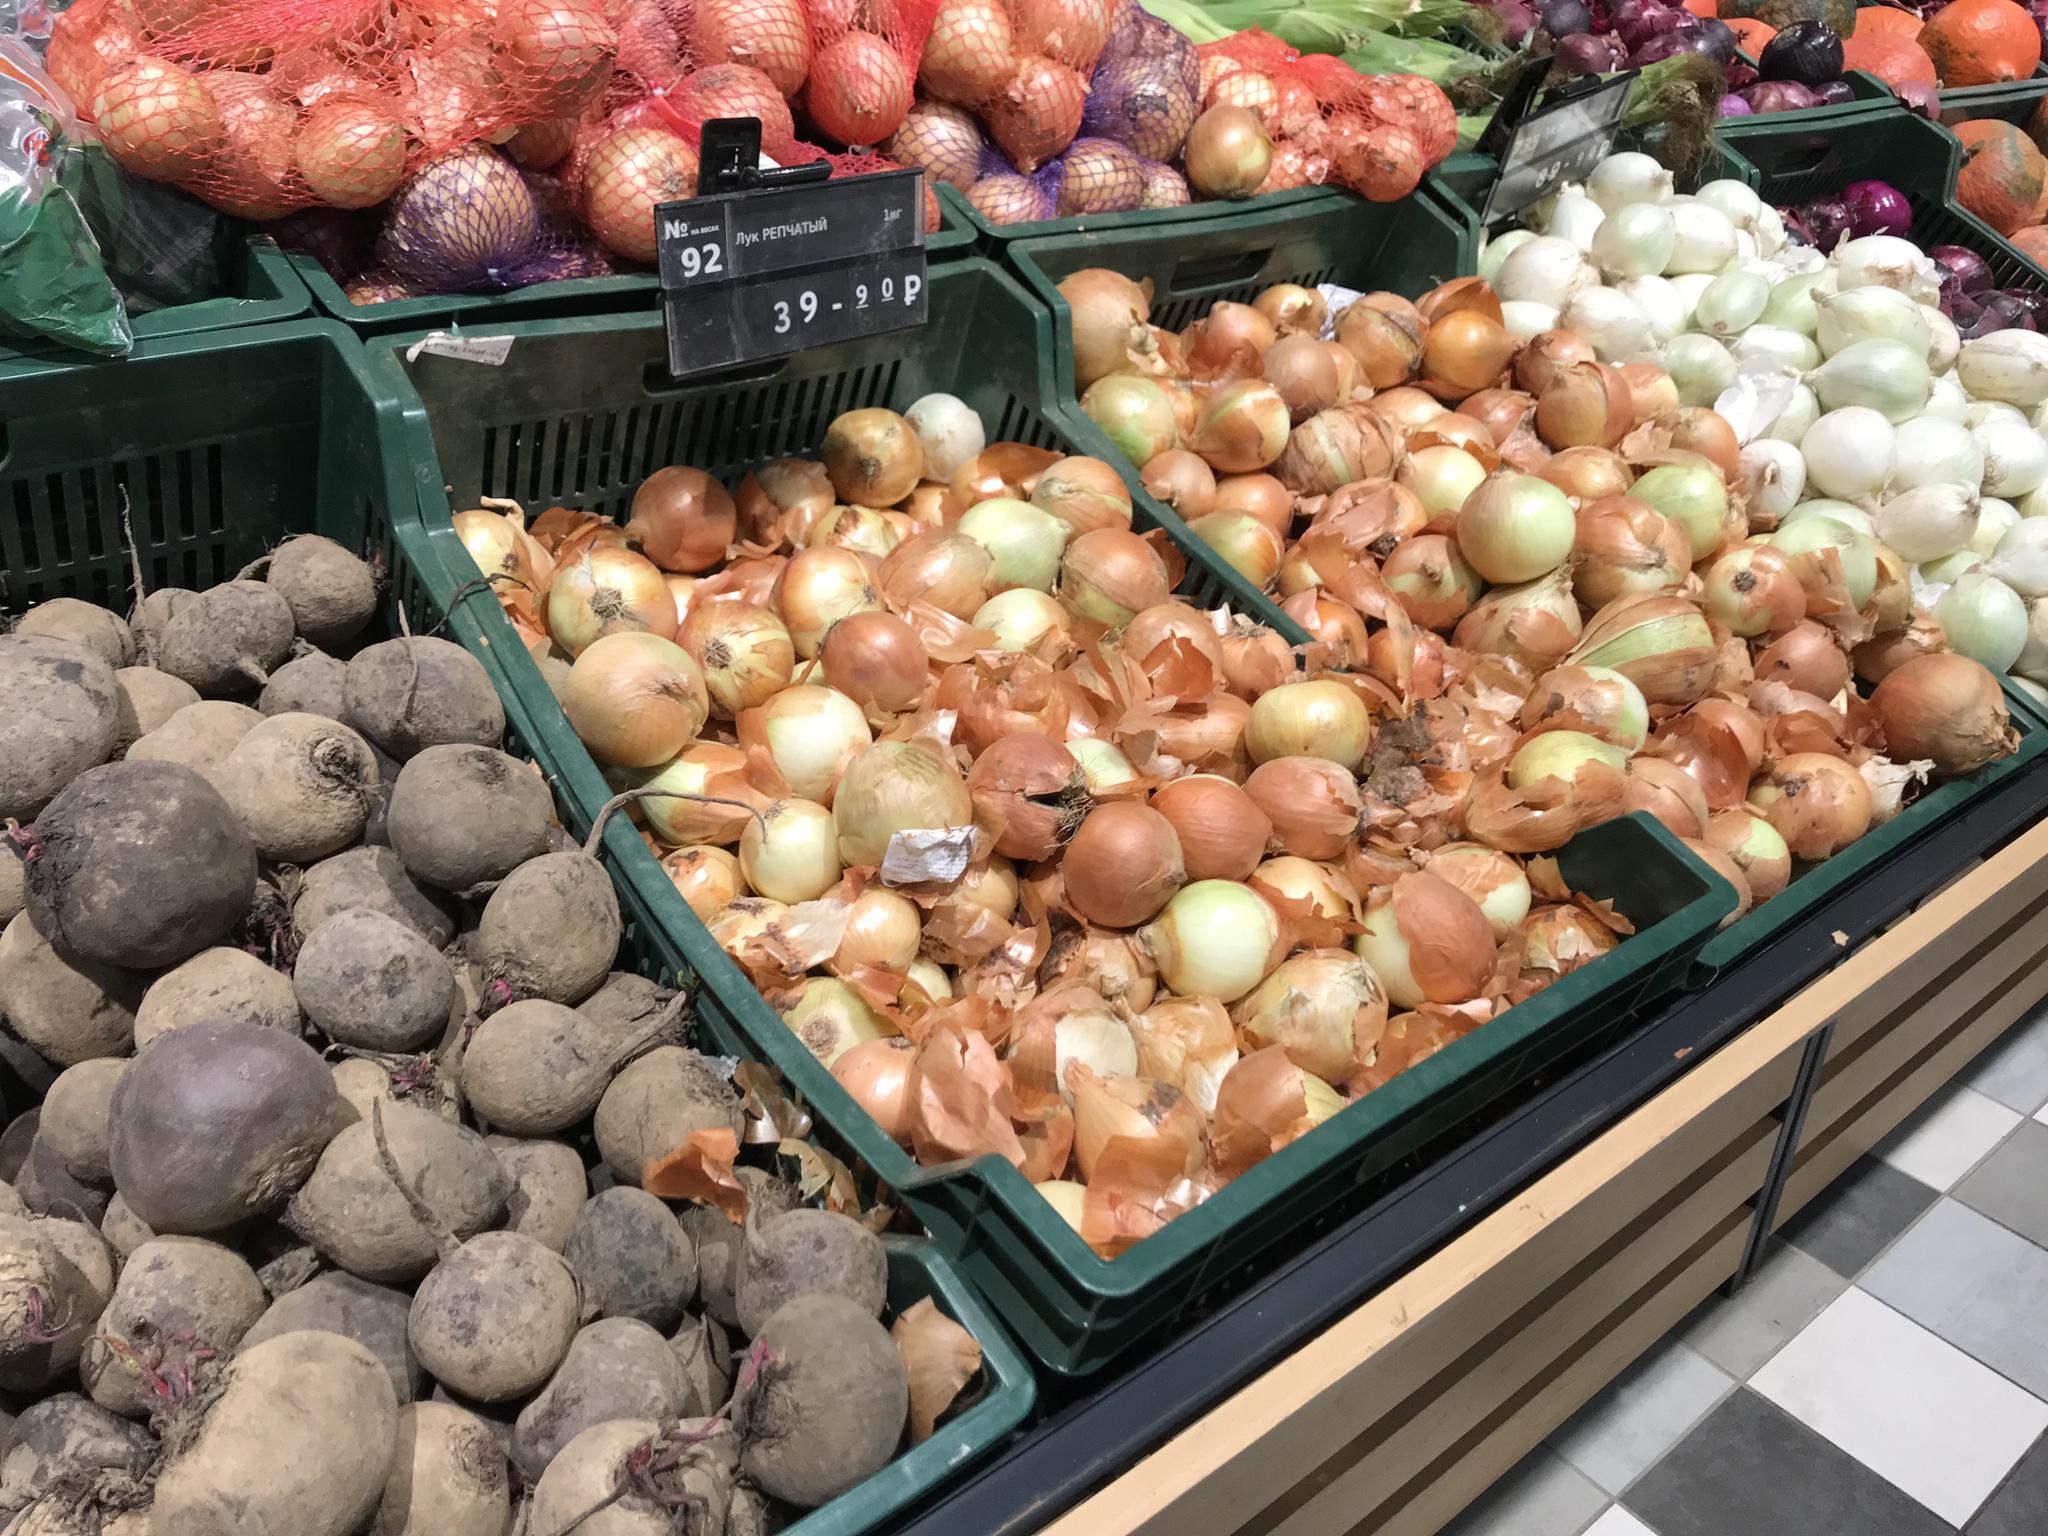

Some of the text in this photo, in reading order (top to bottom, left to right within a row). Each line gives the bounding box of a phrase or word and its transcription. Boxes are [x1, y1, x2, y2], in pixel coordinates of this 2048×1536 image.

[735, 216, 828, 248] Лук РЕПЧАТЫЙ
[681, 242, 723, 278] 92
